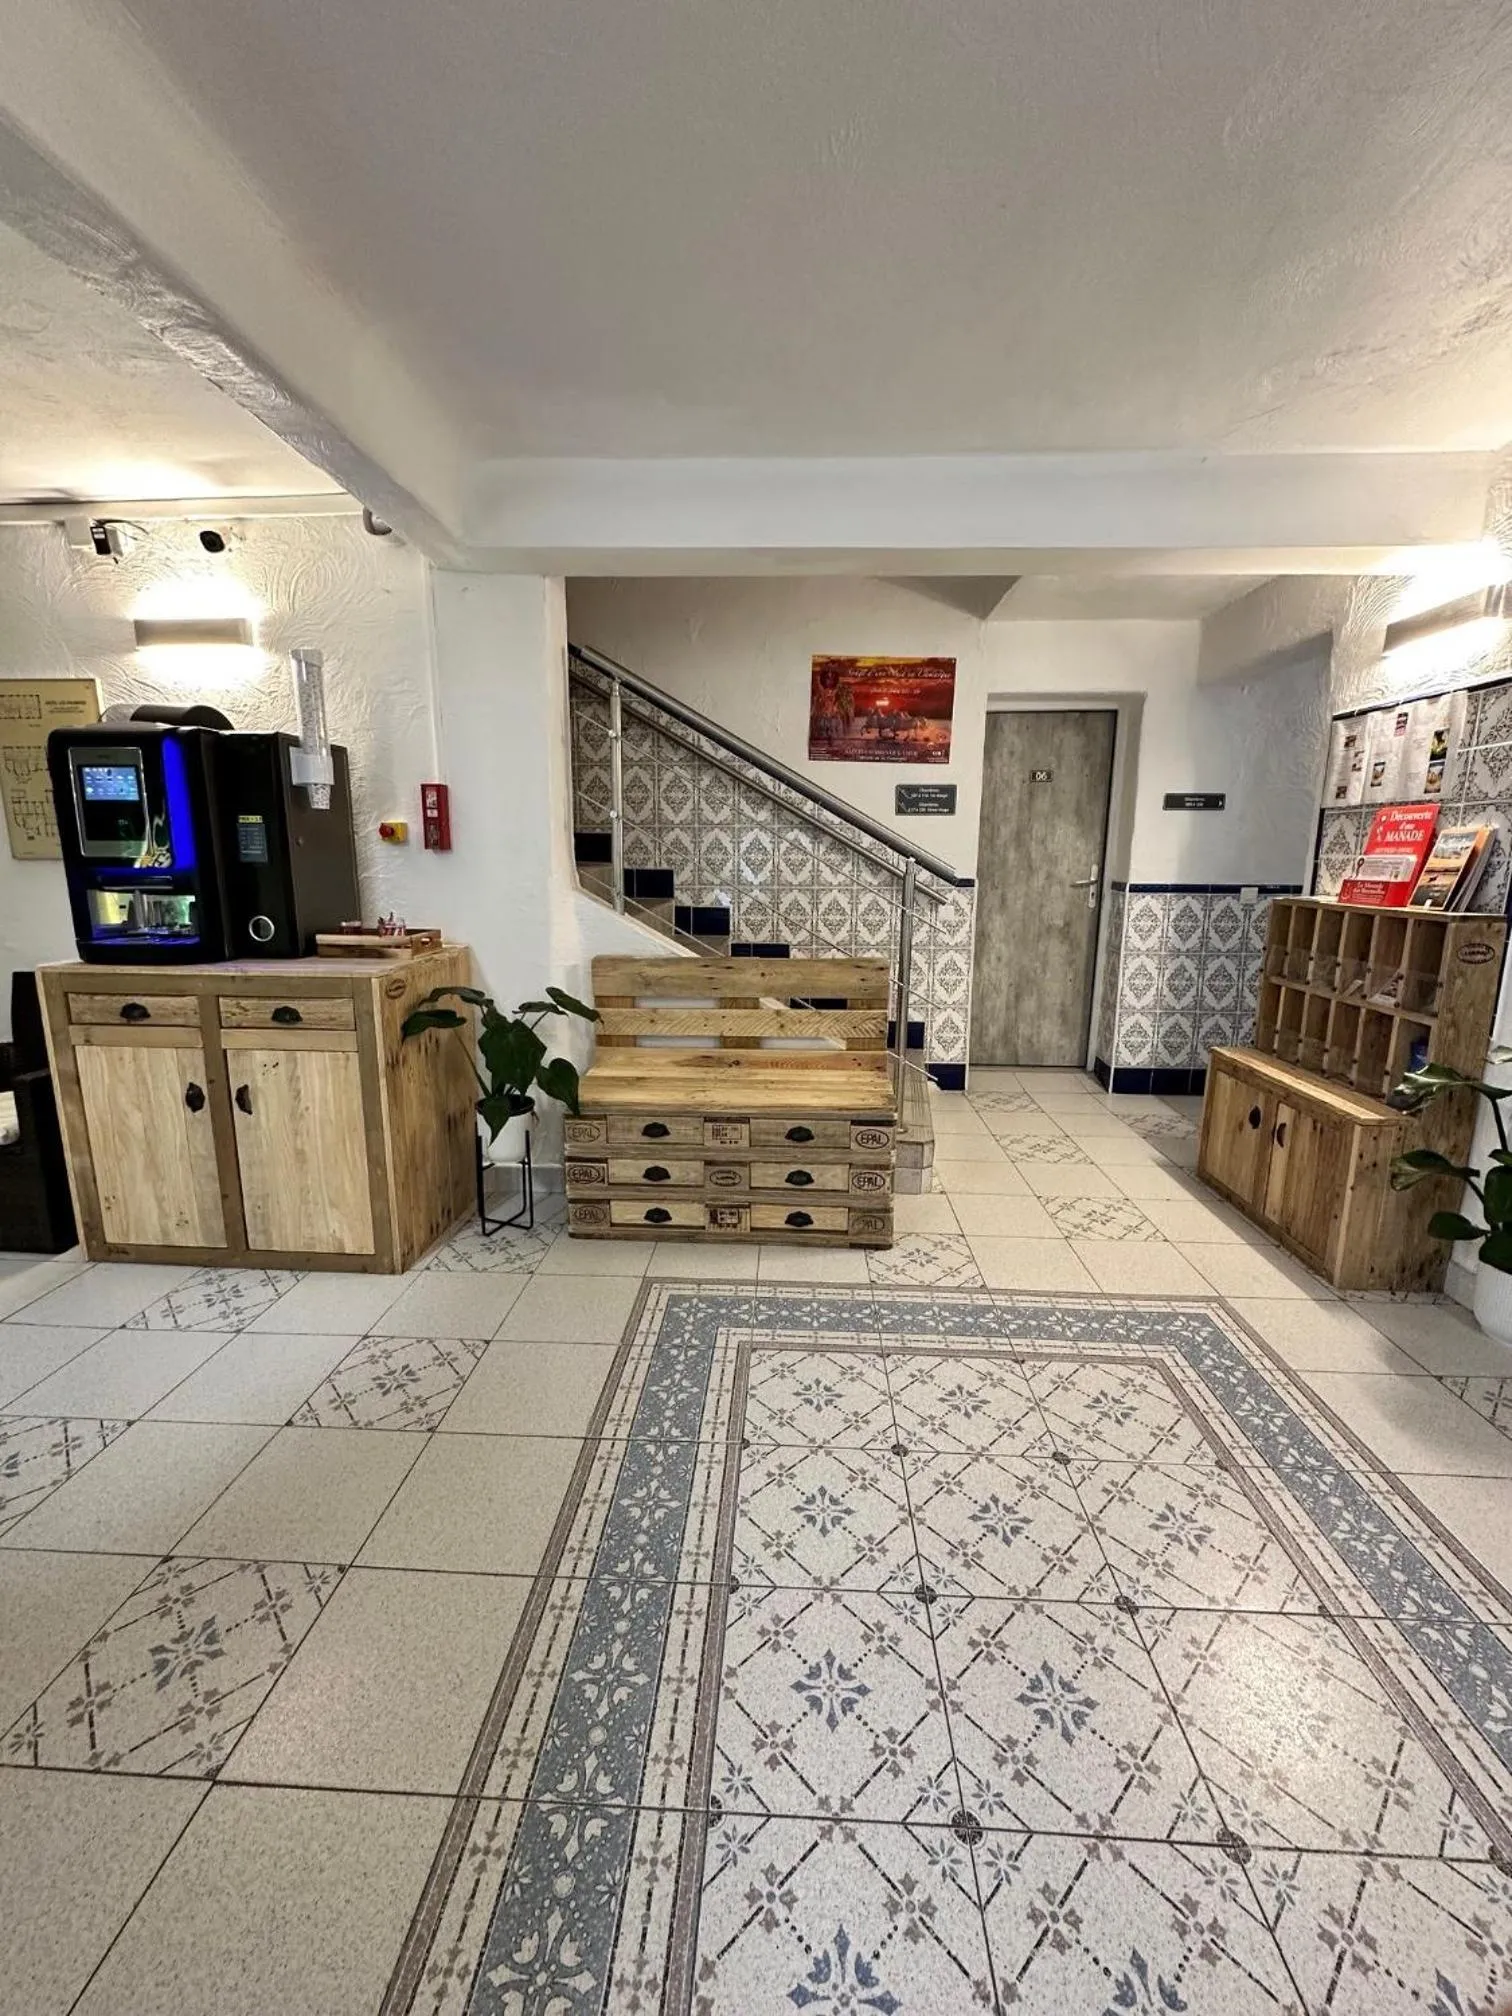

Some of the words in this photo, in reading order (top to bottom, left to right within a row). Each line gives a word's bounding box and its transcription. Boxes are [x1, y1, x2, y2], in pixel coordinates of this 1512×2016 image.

[1035, 771, 1048, 781] 06
[1384, 830, 1425, 842] MANADE
[572, 1127, 596, 1139] EPAL
[861, 1133, 884, 1145] EPAL
[572, 1167, 597, 1180] EPAL
[857, 1176, 882, 1188] EPAL
